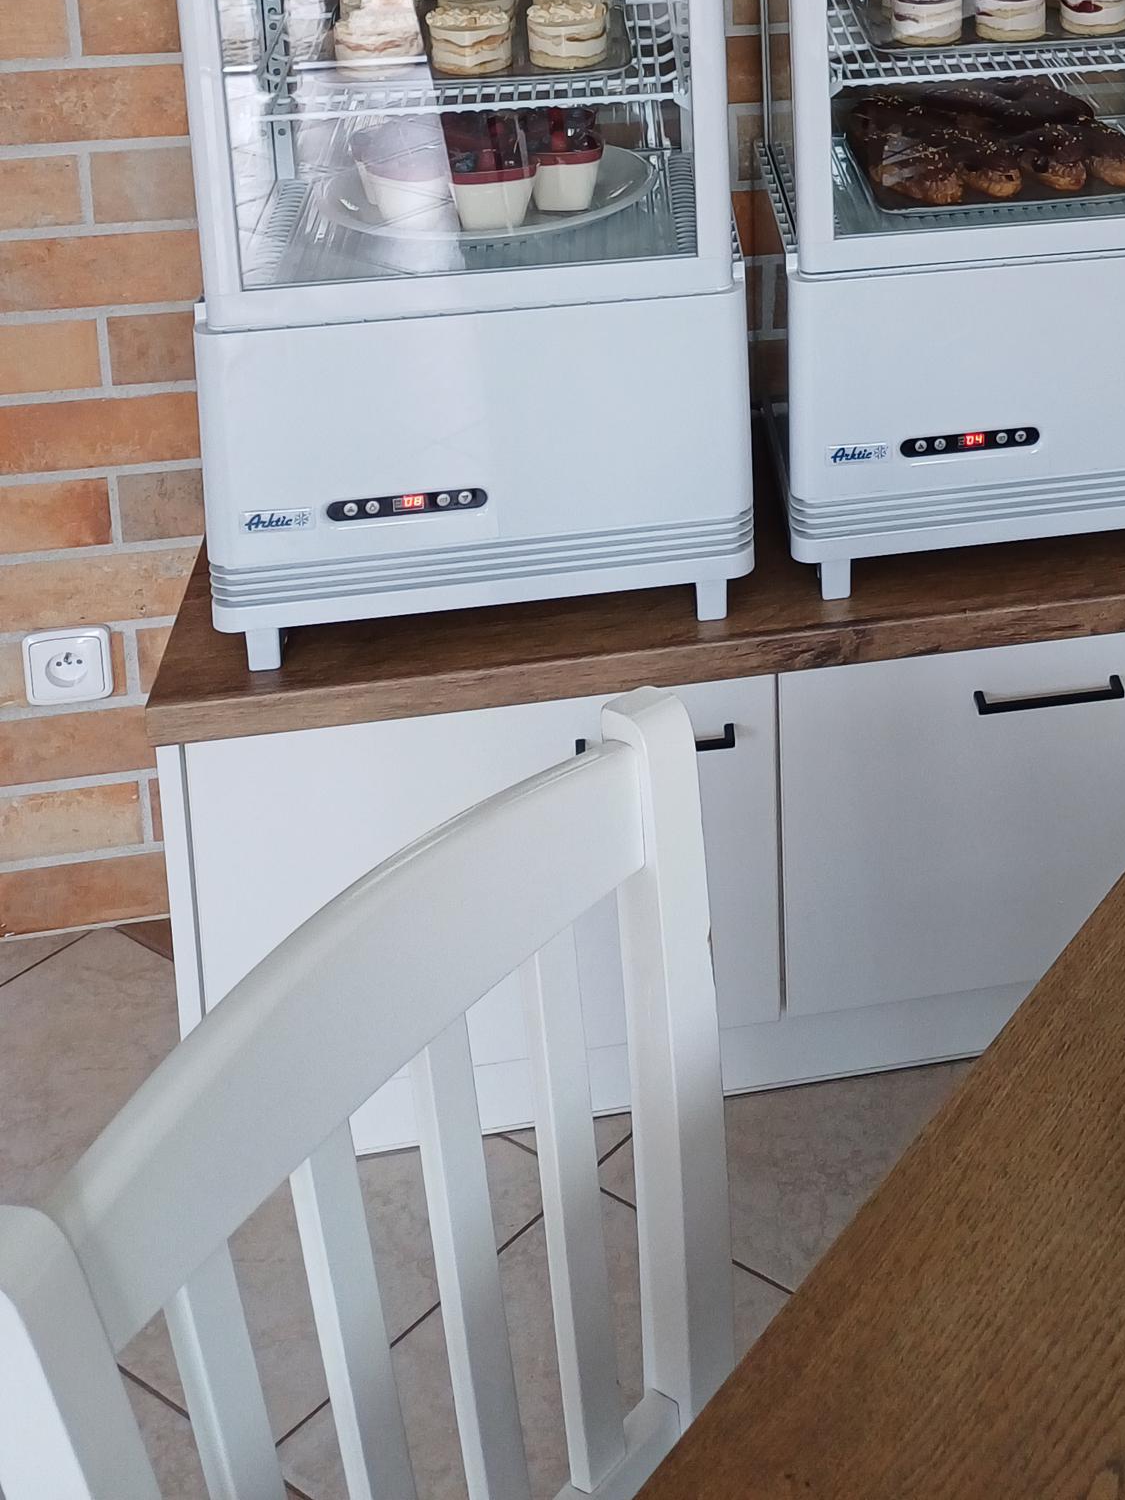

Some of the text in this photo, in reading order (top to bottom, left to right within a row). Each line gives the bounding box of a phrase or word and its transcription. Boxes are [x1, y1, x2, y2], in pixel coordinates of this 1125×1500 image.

[965, 433, 984, 446] 04
[831, 446, 873, 464] Arktic
[244, 512, 293, 531] Arktic
